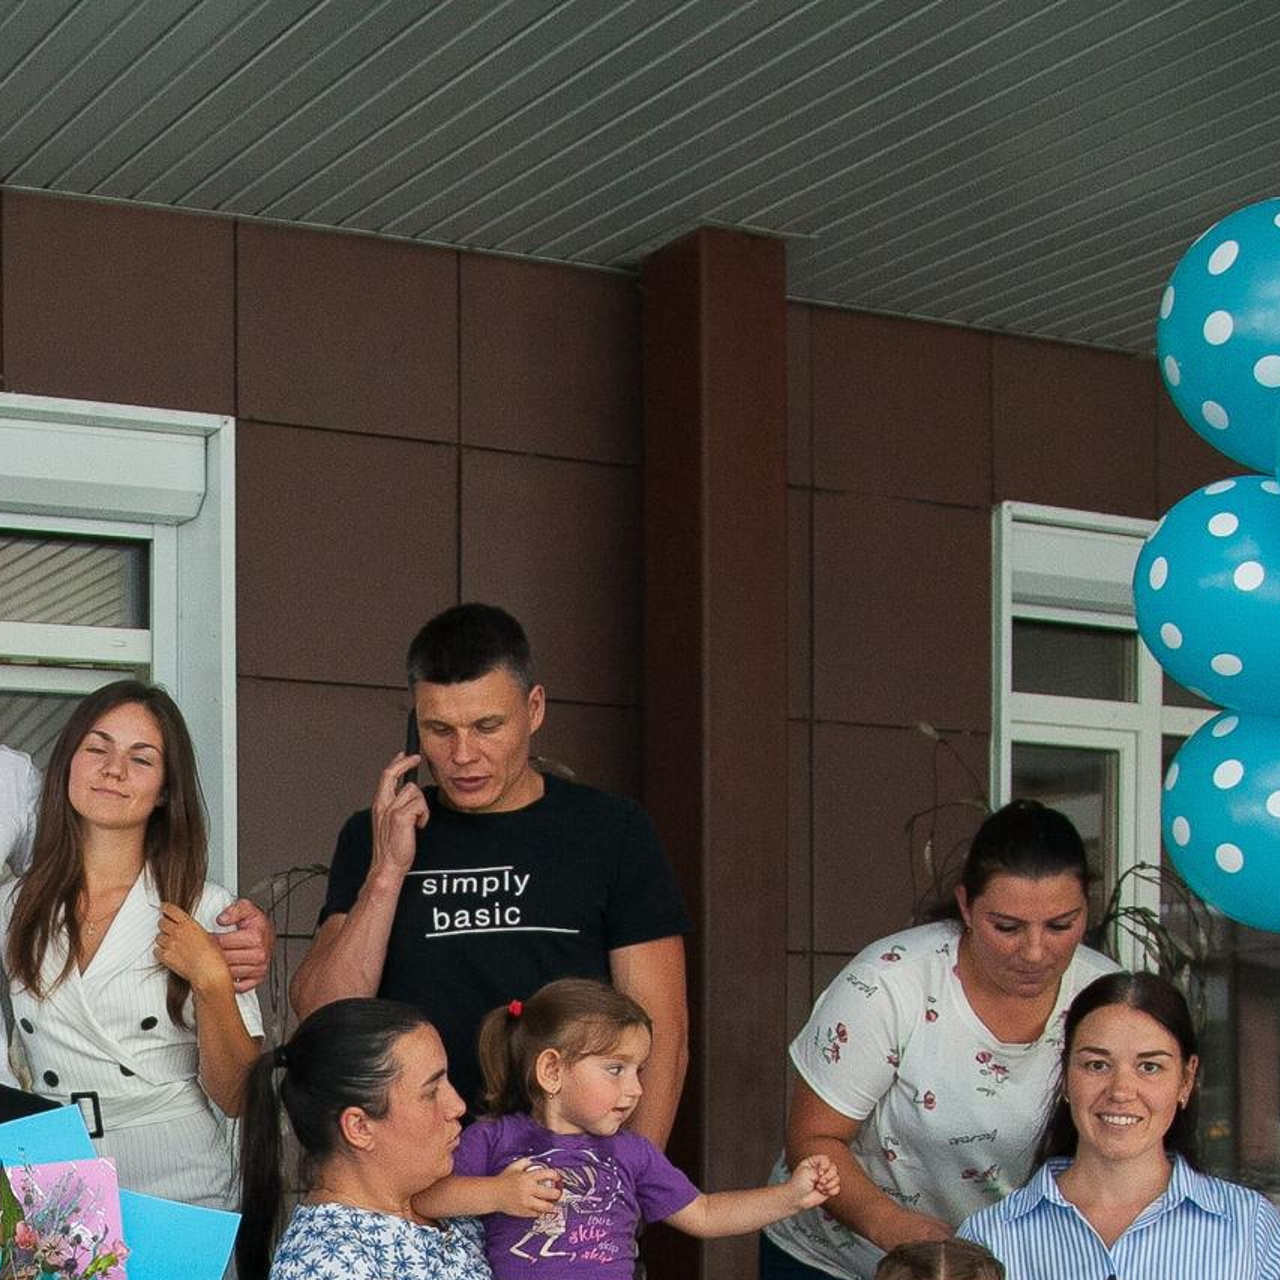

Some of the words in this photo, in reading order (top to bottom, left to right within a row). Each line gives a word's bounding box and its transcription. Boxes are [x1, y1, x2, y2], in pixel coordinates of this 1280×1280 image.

[422, 870, 530, 897] simply
[433, 902, 521, 931] basic
[569, 1223, 607, 1245] skip
